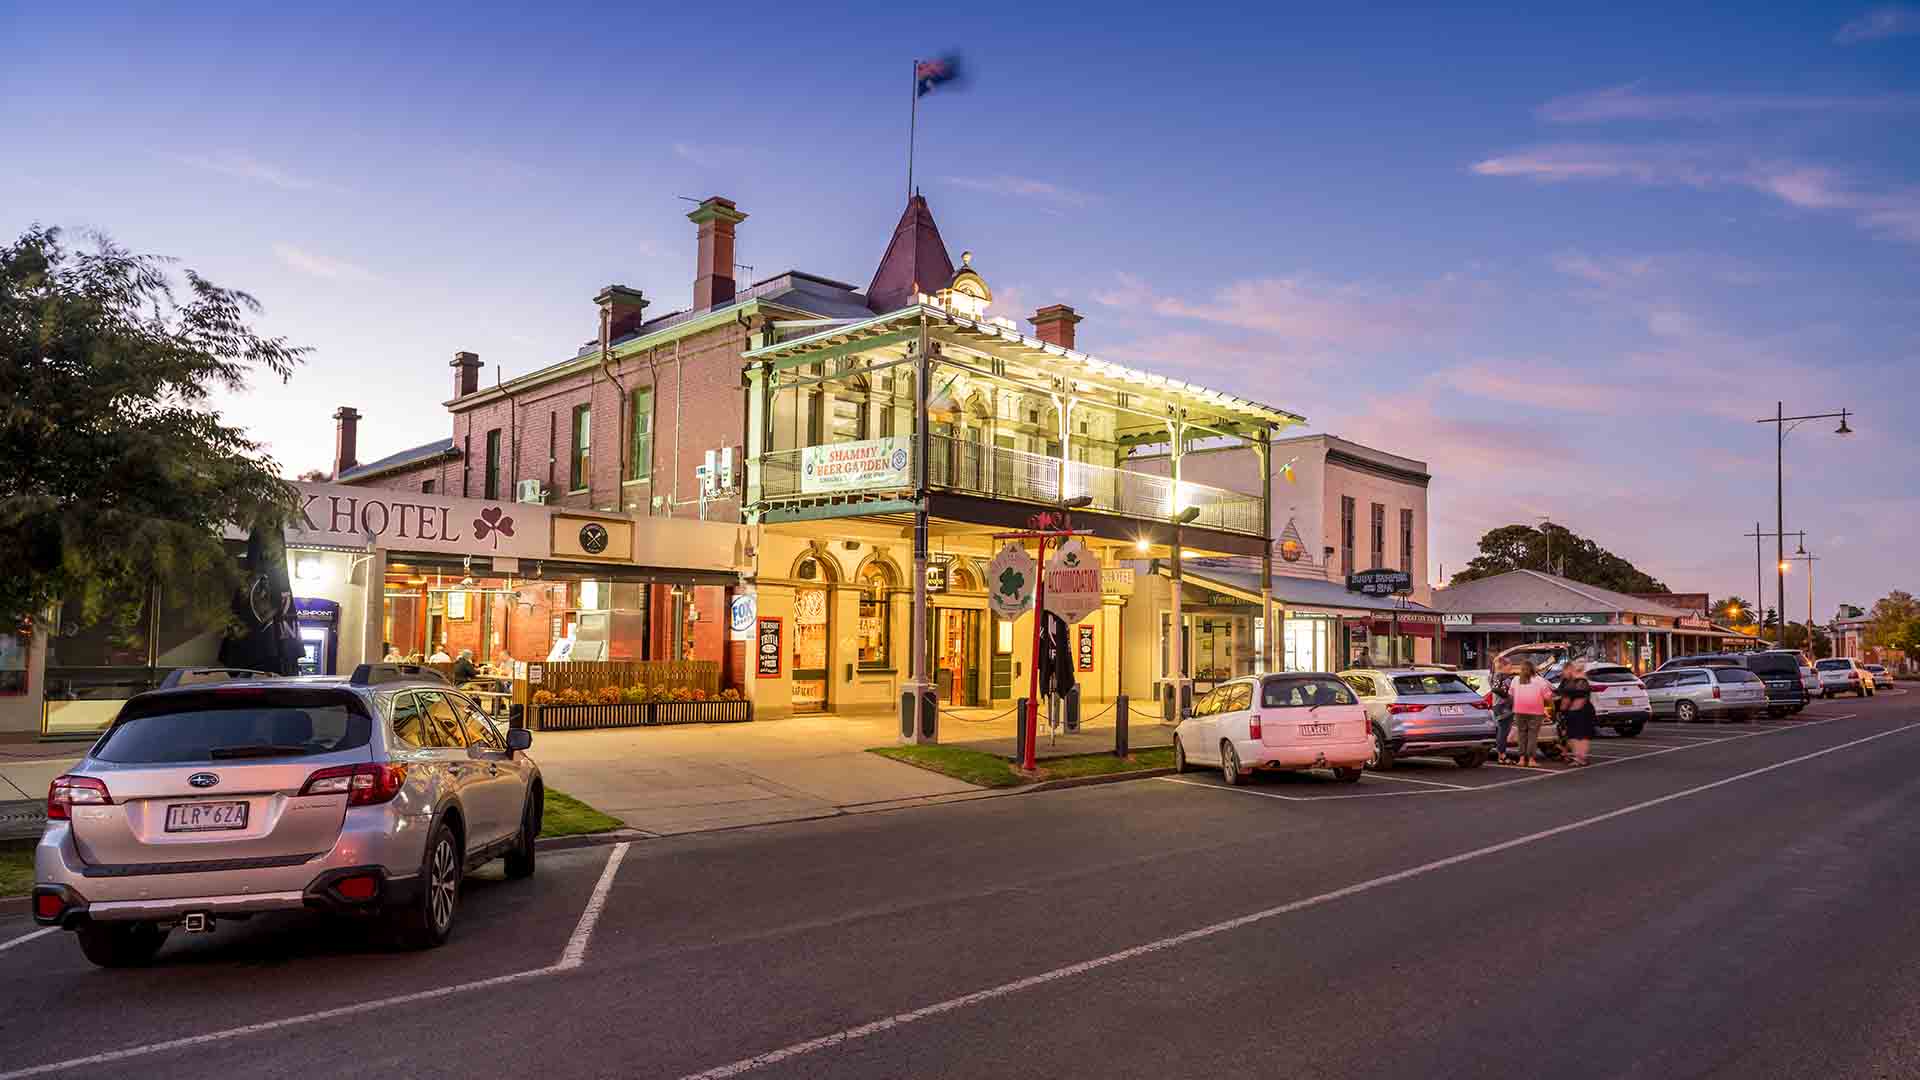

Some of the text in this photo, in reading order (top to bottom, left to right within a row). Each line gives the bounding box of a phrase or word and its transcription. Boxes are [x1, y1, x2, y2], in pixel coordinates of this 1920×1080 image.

[829, 447, 879, 462] SHAMMY
[816, 463, 842, 476] BEER
[328, 495, 460, 542] HOTEL
[732, 602, 753, 621] FOX
[1535, 615, 1592, 624] GIFTS
